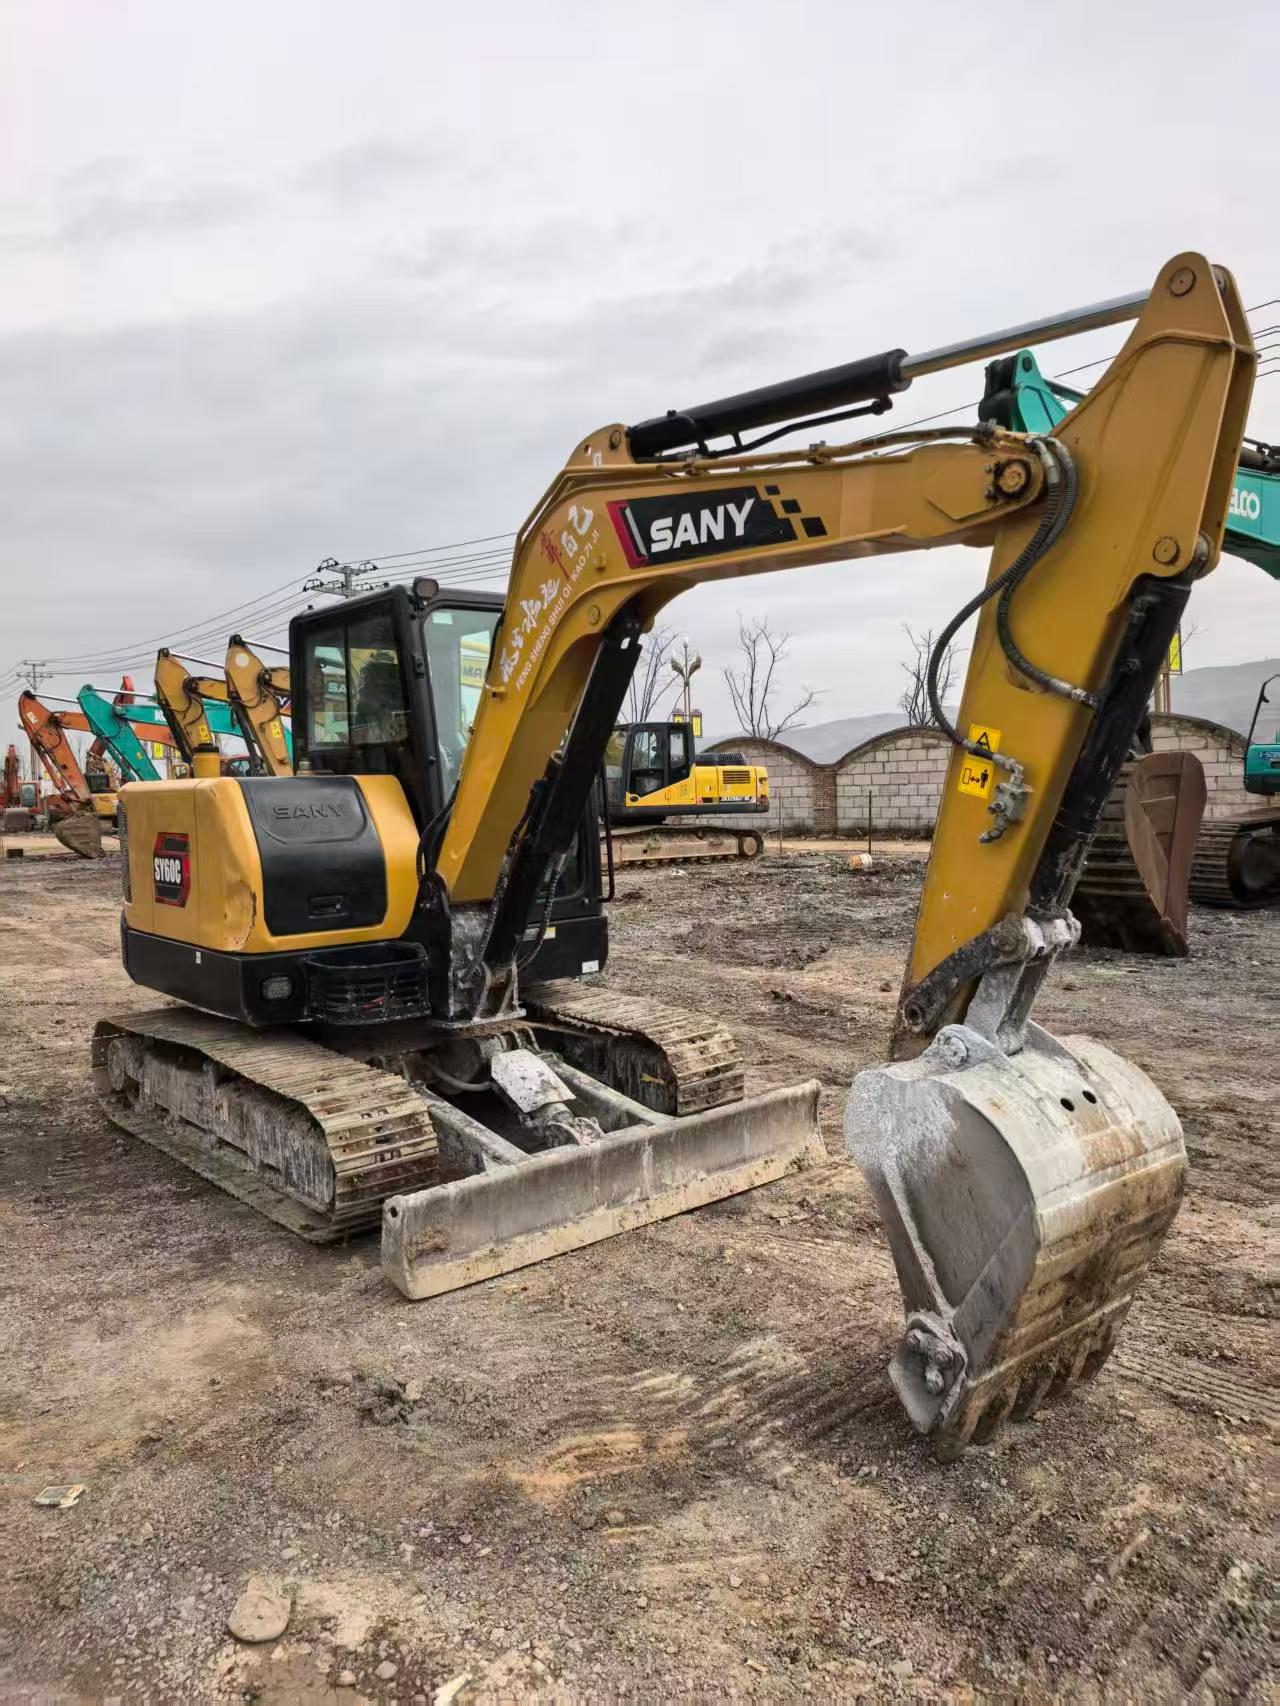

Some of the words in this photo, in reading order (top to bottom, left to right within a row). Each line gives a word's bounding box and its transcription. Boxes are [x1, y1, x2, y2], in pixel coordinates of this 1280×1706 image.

[650, 498, 755, 553] SANY
[516, 661, 532, 691] FENG
[530, 624, 551, 662] SHENG
[549, 597, 565, 625] SHUI
[570, 555, 586, 582] KAO
[272, 802, 343, 820] SANY
[154, 857, 181, 884] SY60C
